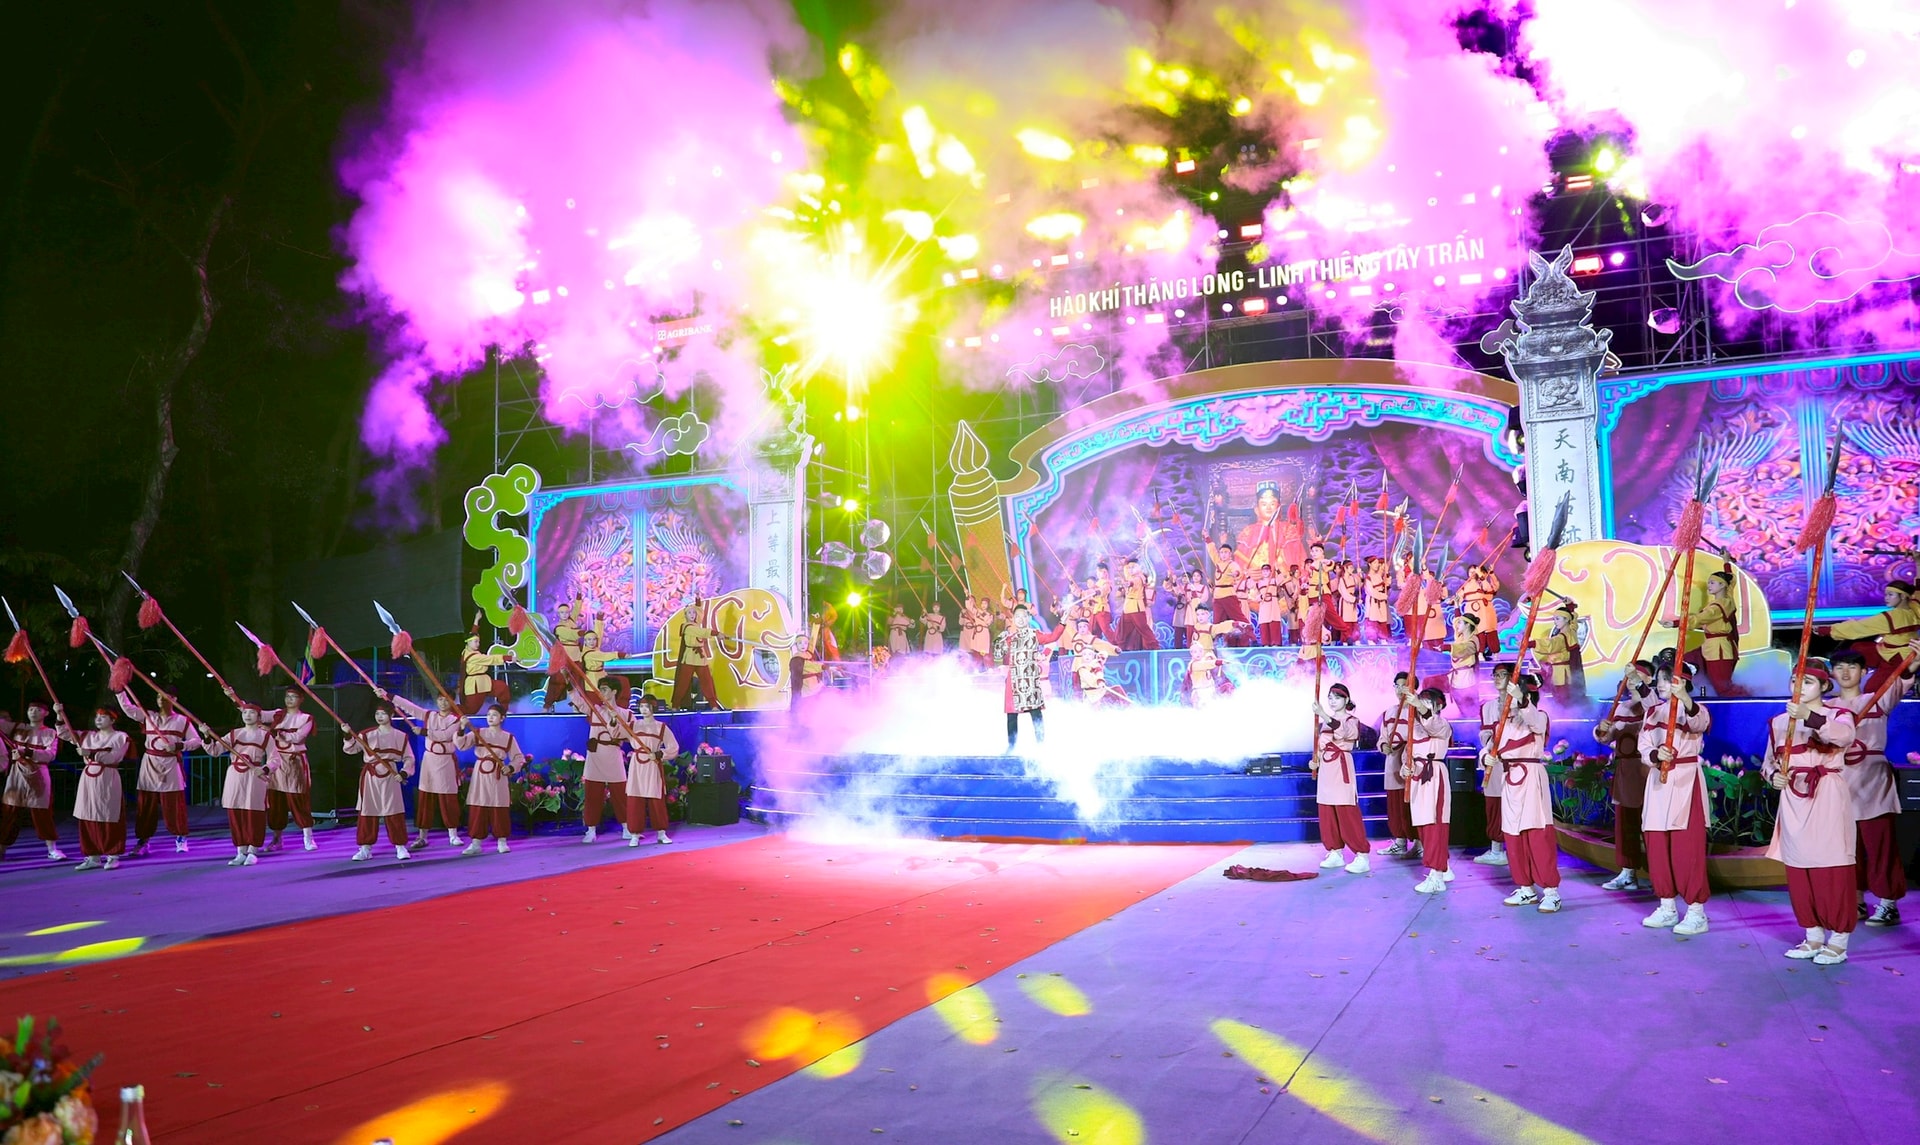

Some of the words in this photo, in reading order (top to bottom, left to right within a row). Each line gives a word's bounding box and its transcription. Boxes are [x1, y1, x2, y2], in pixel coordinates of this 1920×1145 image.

[1050, 289, 1086, 318] HÀO
[1088, 281, 1121, 312] KHÍ
[1122, 276, 1188, 307] THĂNG
[1192, 270, 1244, 297] LONG
[1258, 261, 1305, 289] LINH
[1308, 250, 1381, 281] THIÊNG
[1385, 243, 1422, 272] TÂY
[1424, 229, 1485, 267] TRẤN
[667, 324, 713, 339] AGRIBANK
[765, 508, 781, 591] 上等最
